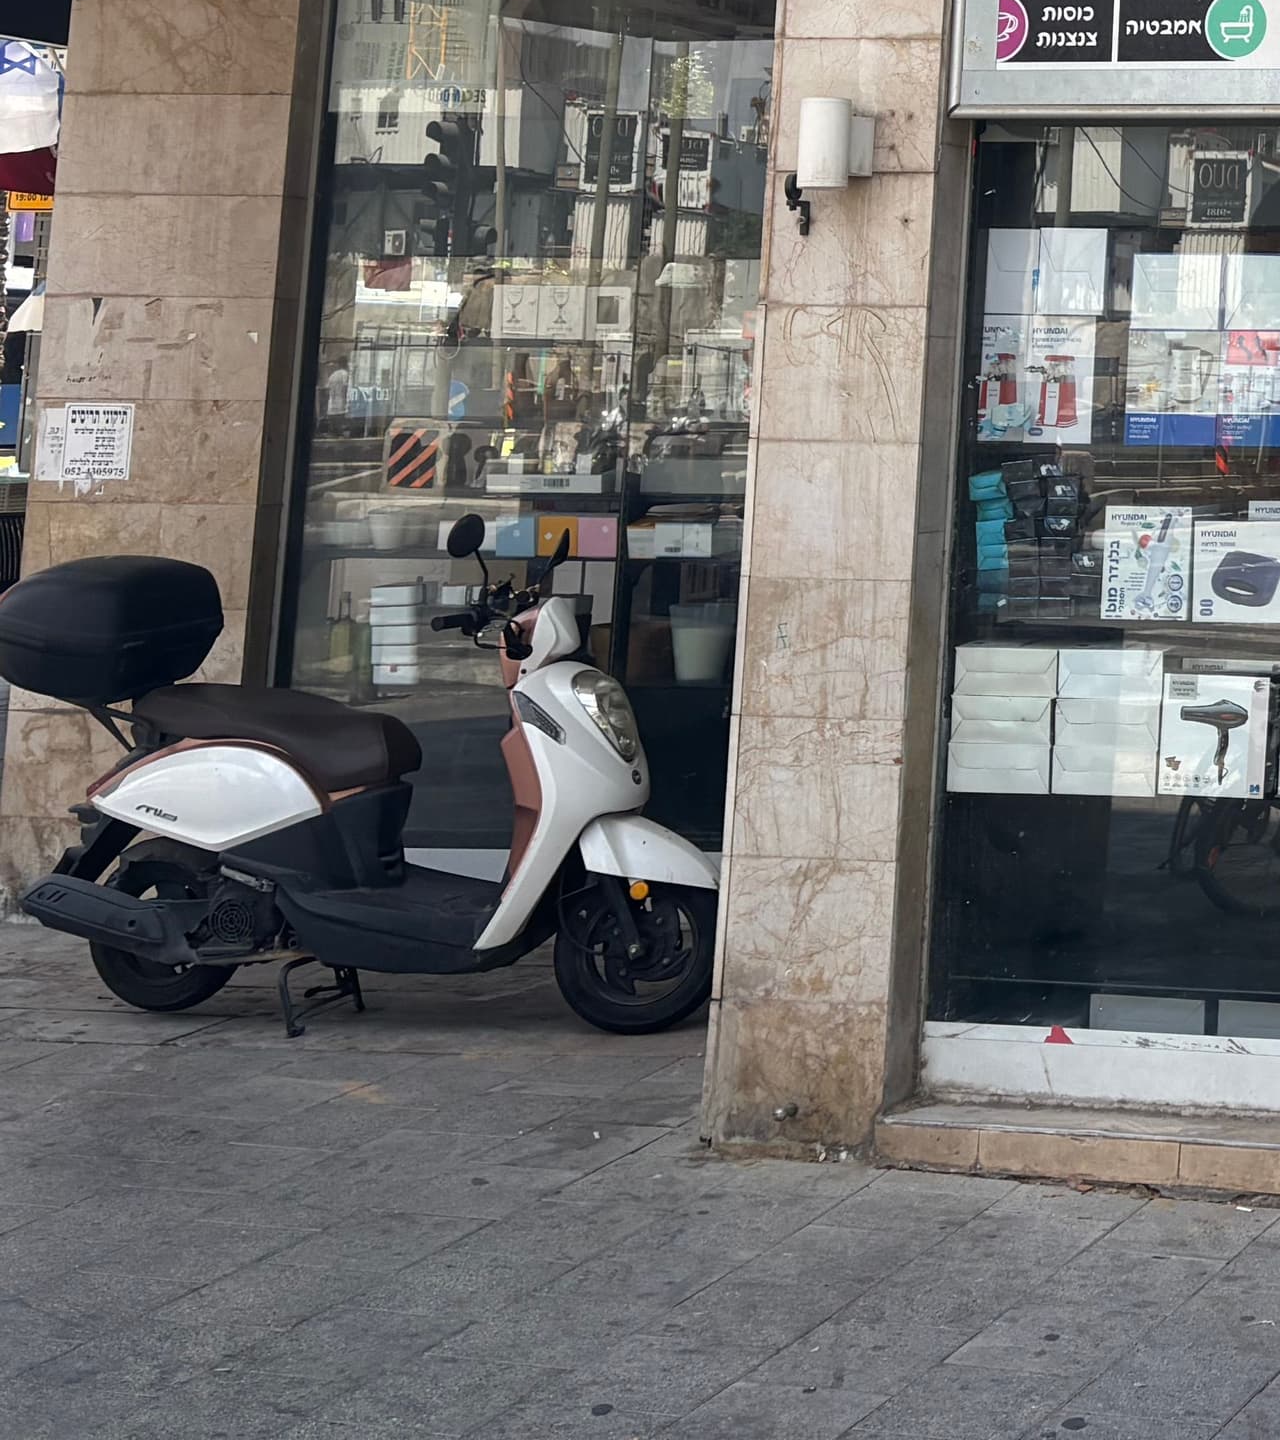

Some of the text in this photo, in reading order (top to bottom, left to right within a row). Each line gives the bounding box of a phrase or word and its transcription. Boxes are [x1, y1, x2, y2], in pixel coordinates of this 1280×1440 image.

[1041, 4, 1095, 22] כוסות
[1125, 17, 1202, 37] אמבטיה
[1036, 29, 1097, 49] צנצנות
[1033, 327, 1068, 335] HYUNDAI
[1111, 513, 1148, 521] HYUNDAI
[1200, 530, 1237, 538] HYUNDAI
[1105, 540, 1120, 613] בלנדר מוט
